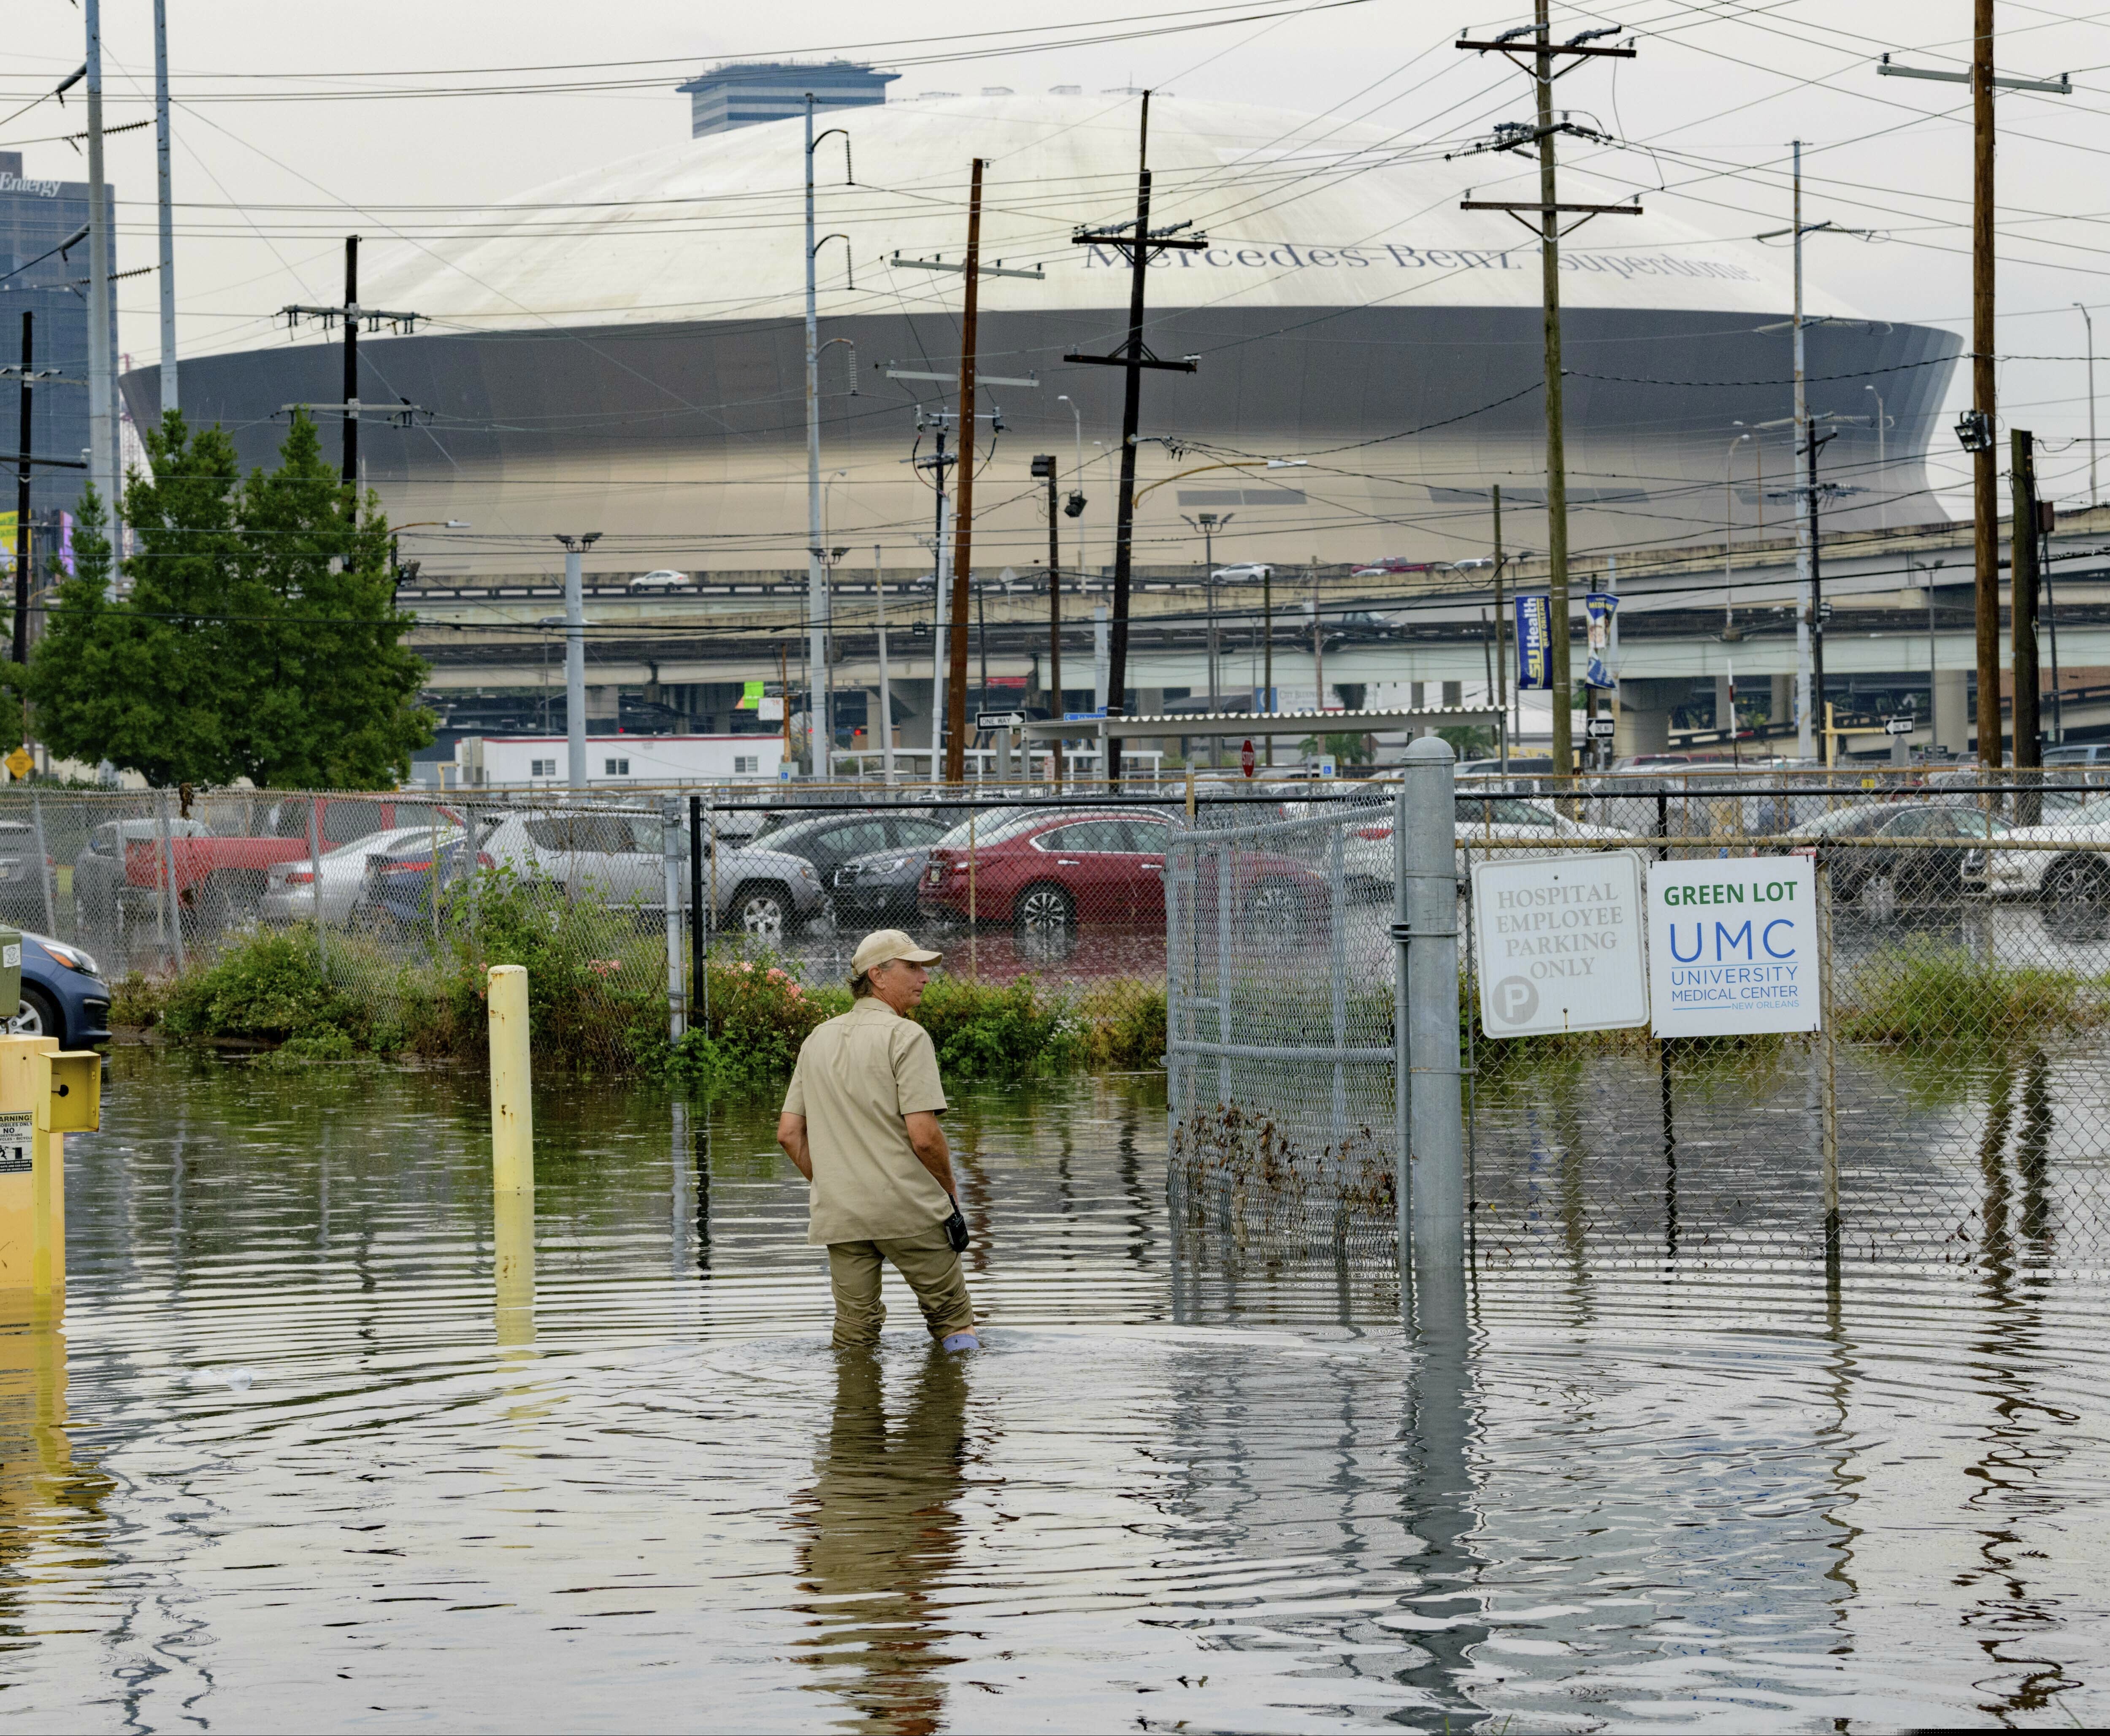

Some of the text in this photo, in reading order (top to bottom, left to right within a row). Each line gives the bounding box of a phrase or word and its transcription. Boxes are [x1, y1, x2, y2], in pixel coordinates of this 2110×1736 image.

[0, 172, 62, 197] Entergy
[1539, 598, 1547, 629] ORLEANS
[1523, 597, 1541, 689] LSU Health
[1242, 751, 1254, 766] STOP
[1497, 883, 1618, 909] HOSPITAL
[1664, 881, 1798, 906] GREEN LOT
[1496, 906, 1623, 934] EMPLOYEE
[1505, 931, 1617, 957] PARKING
[1670, 919, 1796, 963] UMC
[1530, 957, 1595, 979] ONLY
[1672, 966, 1798, 986] UNIVERSITY
[1504, 983, 1530, 1018] P
[1672, 986, 1798, 1002] MEDICAL CENTER
[1732, 1000, 1799, 1010] NEW ORLEANS
